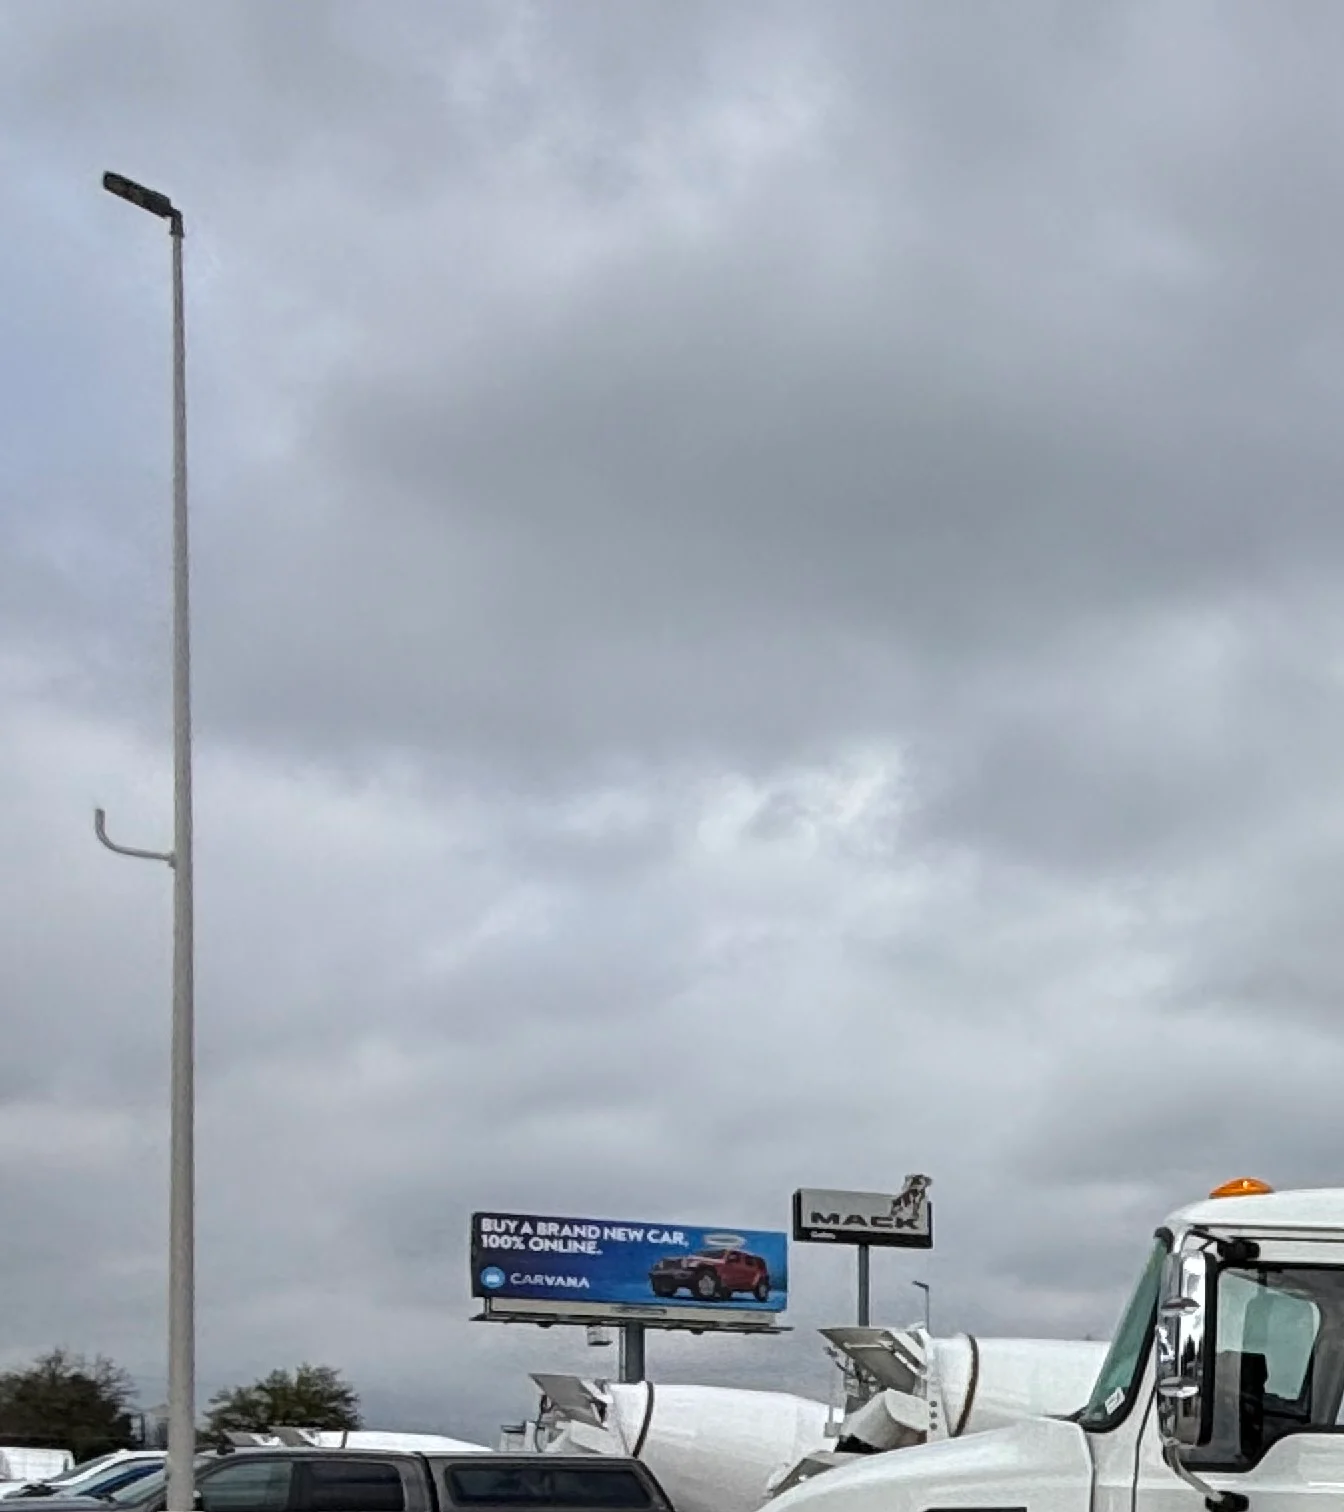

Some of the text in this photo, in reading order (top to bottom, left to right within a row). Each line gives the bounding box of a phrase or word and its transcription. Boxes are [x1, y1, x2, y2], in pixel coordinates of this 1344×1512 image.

[481, 1218, 518, 1234] BUY
[521, 1220, 534, 1235] A
[536, 1221, 601, 1240] BRAND
[602, 1226, 645, 1242] NEW
[810, 1211, 919, 1229] MACK
[481, 1234, 604, 1256] 100% ONLINE.
[509, 1272, 590, 1290] CARVANA
